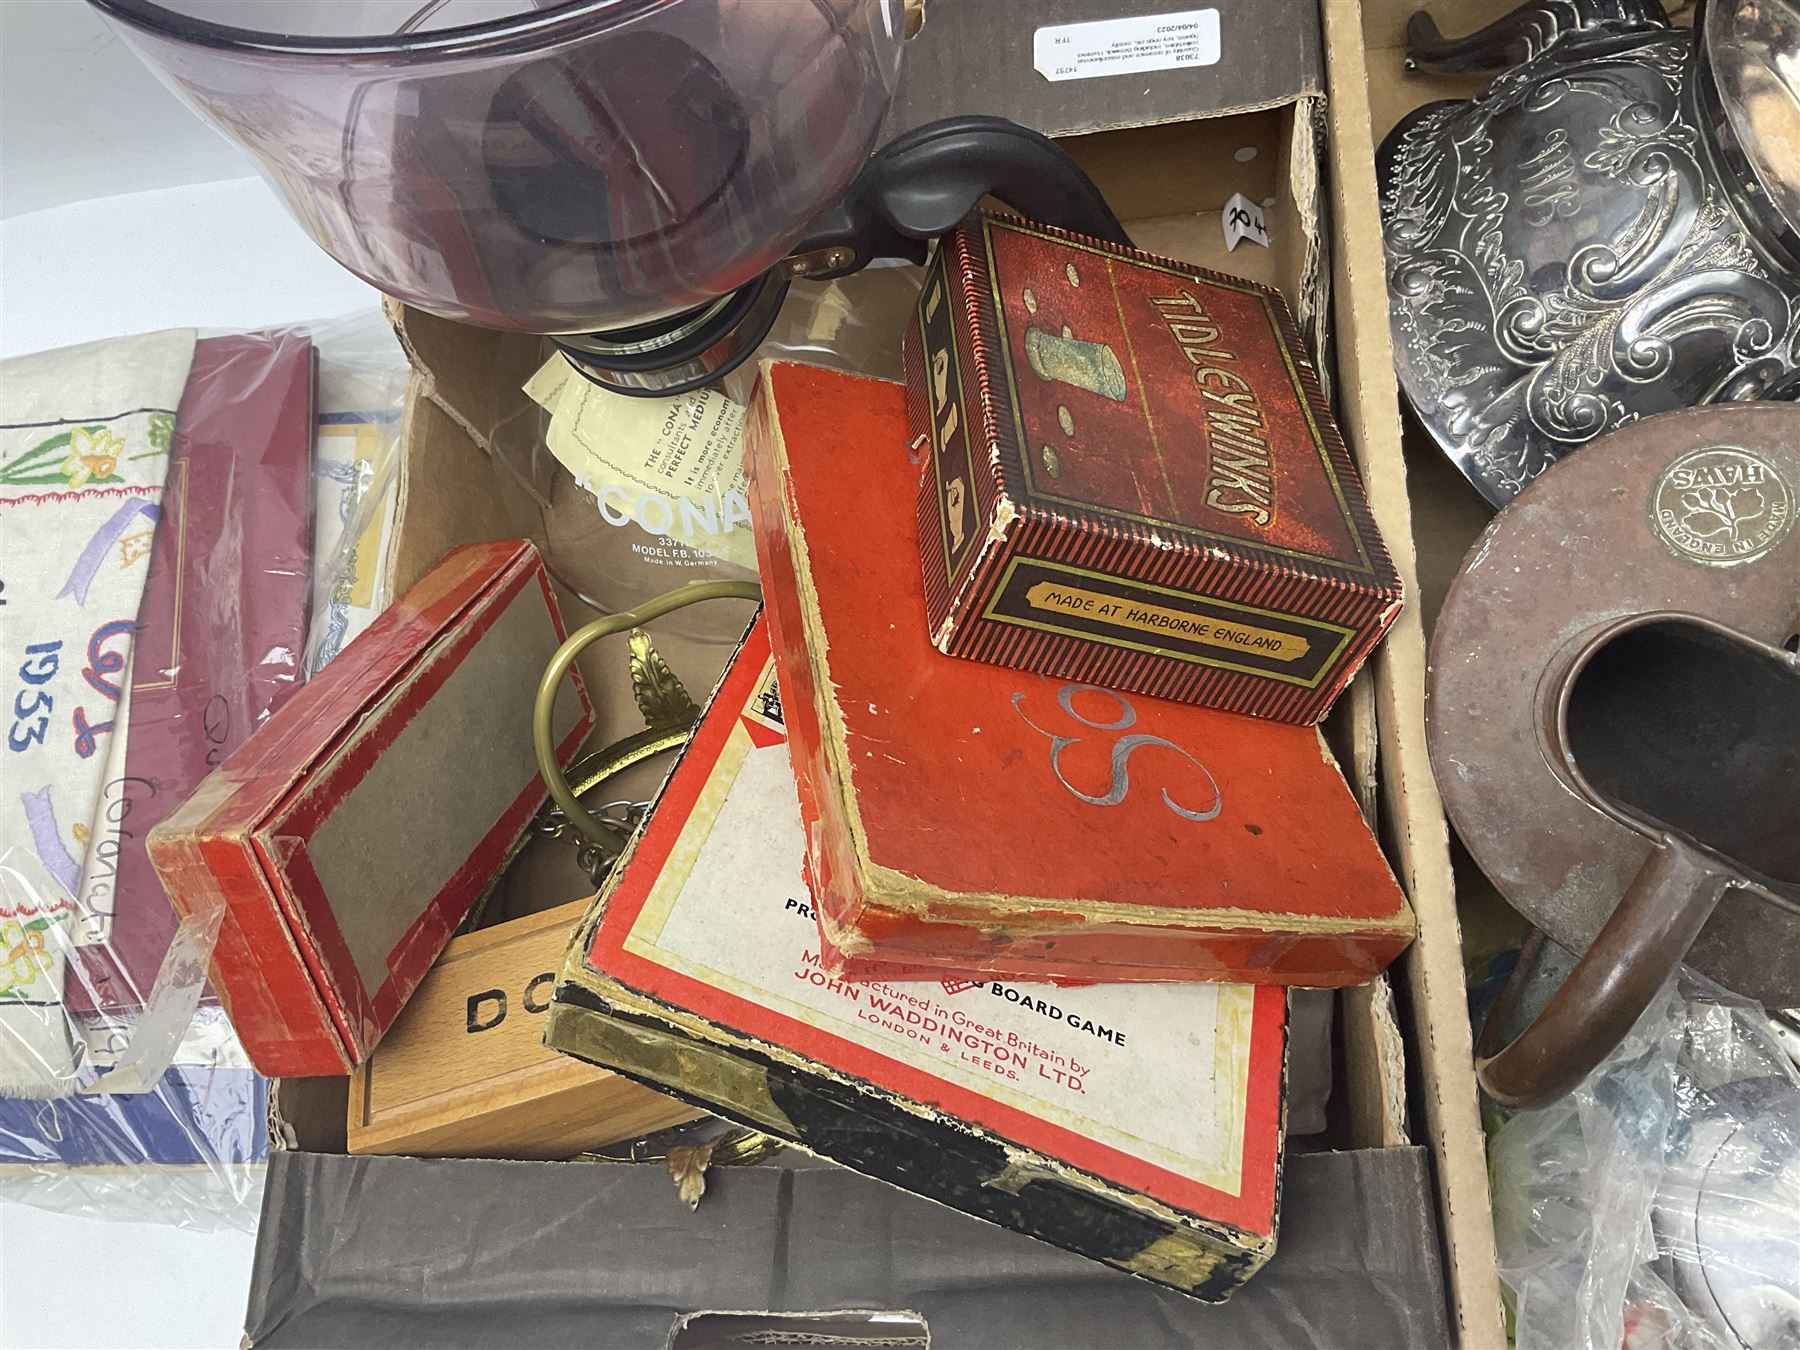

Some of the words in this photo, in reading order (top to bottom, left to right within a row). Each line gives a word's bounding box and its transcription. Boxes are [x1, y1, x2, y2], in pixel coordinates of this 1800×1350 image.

[1054, 36, 1071, 45] TFR
[1156, 23, 1199, 33] 04/04/2023
[1055, 65, 1078, 74] 14757
[1176, 53, 1199, 61] 73038
[1150, 288, 1276, 528] TIDLEYWINKS
[644, 448, 661, 469] THE
[657, 423, 687, 474] consultants
[665, 434, 692, 478] PERFECT
[683, 477, 695, 486] It
[698, 440, 713, 464] more
[711, 398, 730, 437] econom
[697, 434, 728, 490] immediately
[724, 408, 737, 433] after
[705, 483, 714, 493] to
[1672, 464, 1765, 489] HAWS
[1660, 509, 1726, 555] ENGLAND
[1757, 501, 1787, 541] MADE
[632, 543, 671, 557] MODEL
[644, 556, 664, 565] Made
[1732, 539, 1754, 554] IN
[1044, 590, 1095, 612] MADE
[1098, 602, 1123, 617] AT
[1126, 608, 1210, 637] HARBORNE
[1213, 627, 1283, 652] ENGLAND
[8, 640, 63, 752] 1953
[794, 968, 860, 1001] JOHN
[869, 995, 1028, 1070] WADDINGTON
[1039, 1063, 1086, 1095] LTD.
[991, 982, 1063, 1021] BOARD
[1066, 1014, 1126, 1047] GAME
[858, 1009, 931, 1045] LONDON
[940, 1042, 950, 1053] &
[960, 1051, 1020, 1081] LEEDS.
[934, 1004, 949, 1019] in
[952, 1011, 1003, 1041] Great
[1007, 1032, 1065, 1067] Britain
[1069, 1057, 1091, 1077] by
